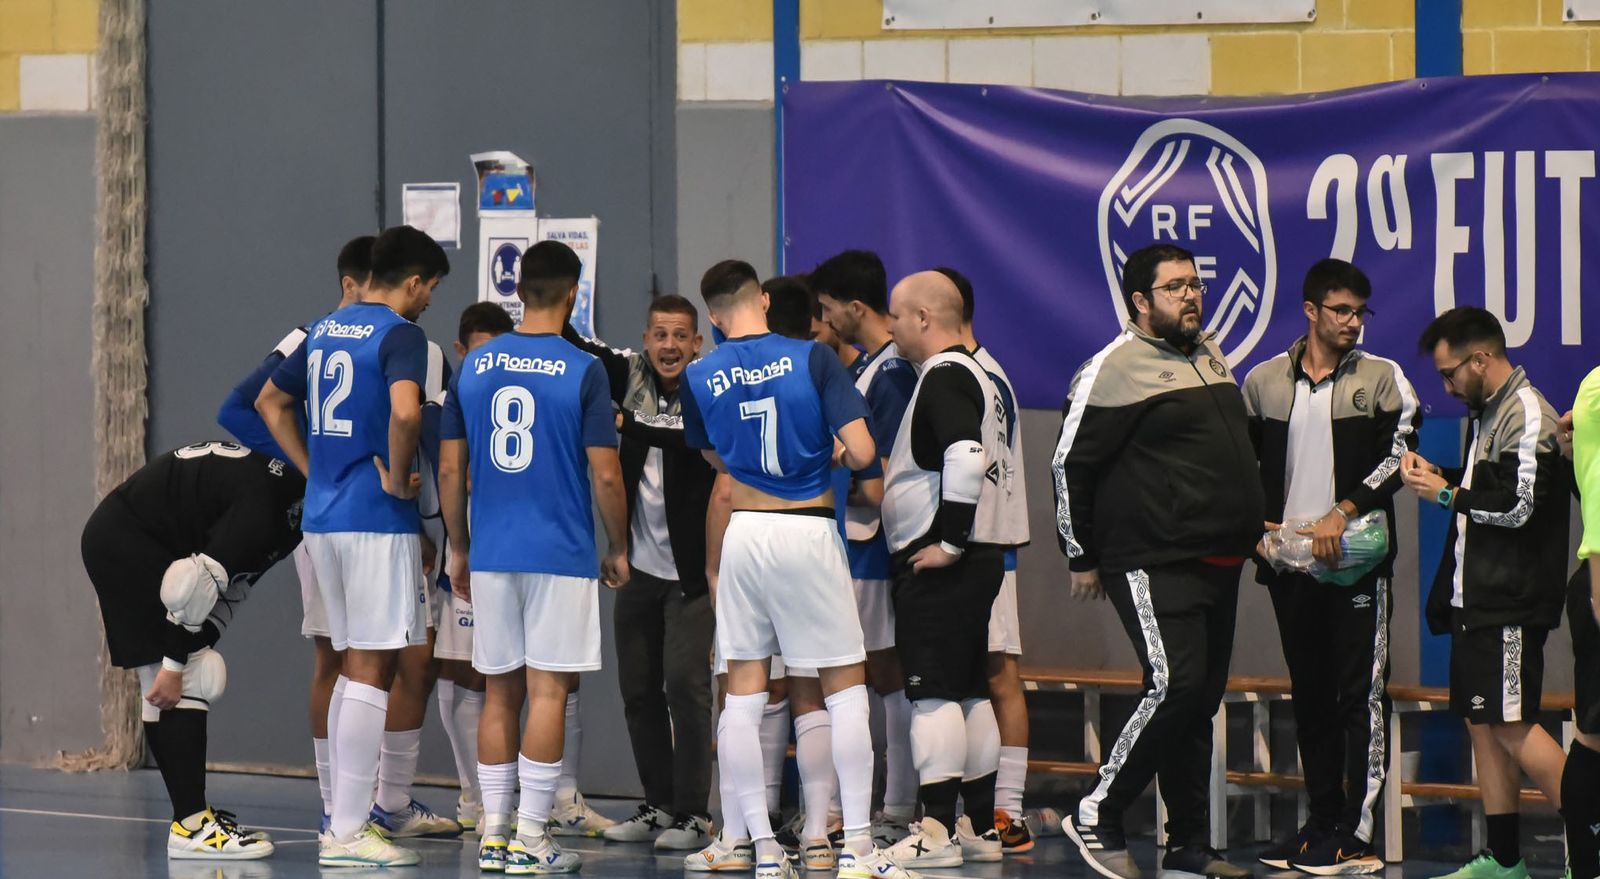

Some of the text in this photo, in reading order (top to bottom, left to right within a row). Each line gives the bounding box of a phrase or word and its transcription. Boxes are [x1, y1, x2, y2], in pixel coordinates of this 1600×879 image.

[307, 349, 354, 438] 12
[490, 385, 535, 473] 8
[739, 396, 784, 478] 7
